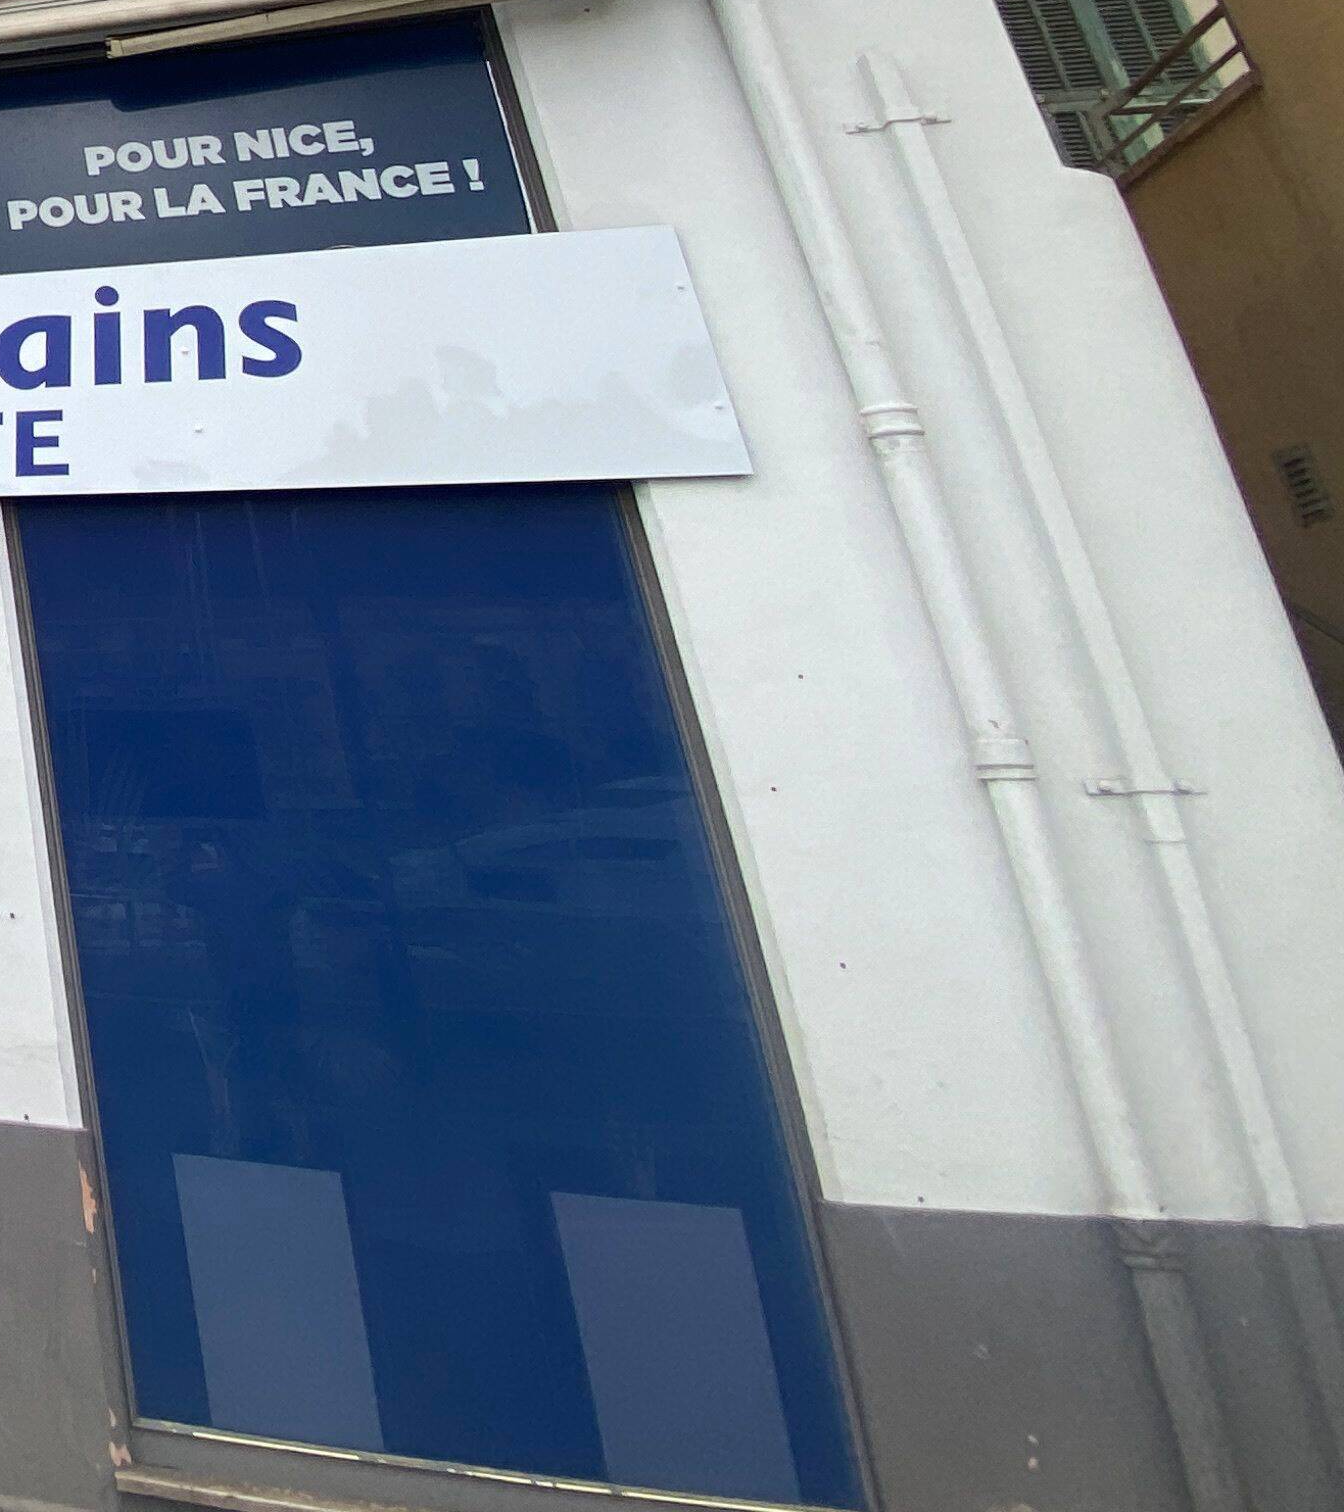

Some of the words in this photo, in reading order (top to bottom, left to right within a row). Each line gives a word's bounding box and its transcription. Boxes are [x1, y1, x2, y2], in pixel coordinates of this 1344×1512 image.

[83, 135, 227, 176] POUR
[234, 120, 376, 162] NICE,
[7, 190, 146, 231] POUR
[154, 183, 226, 218] LA
